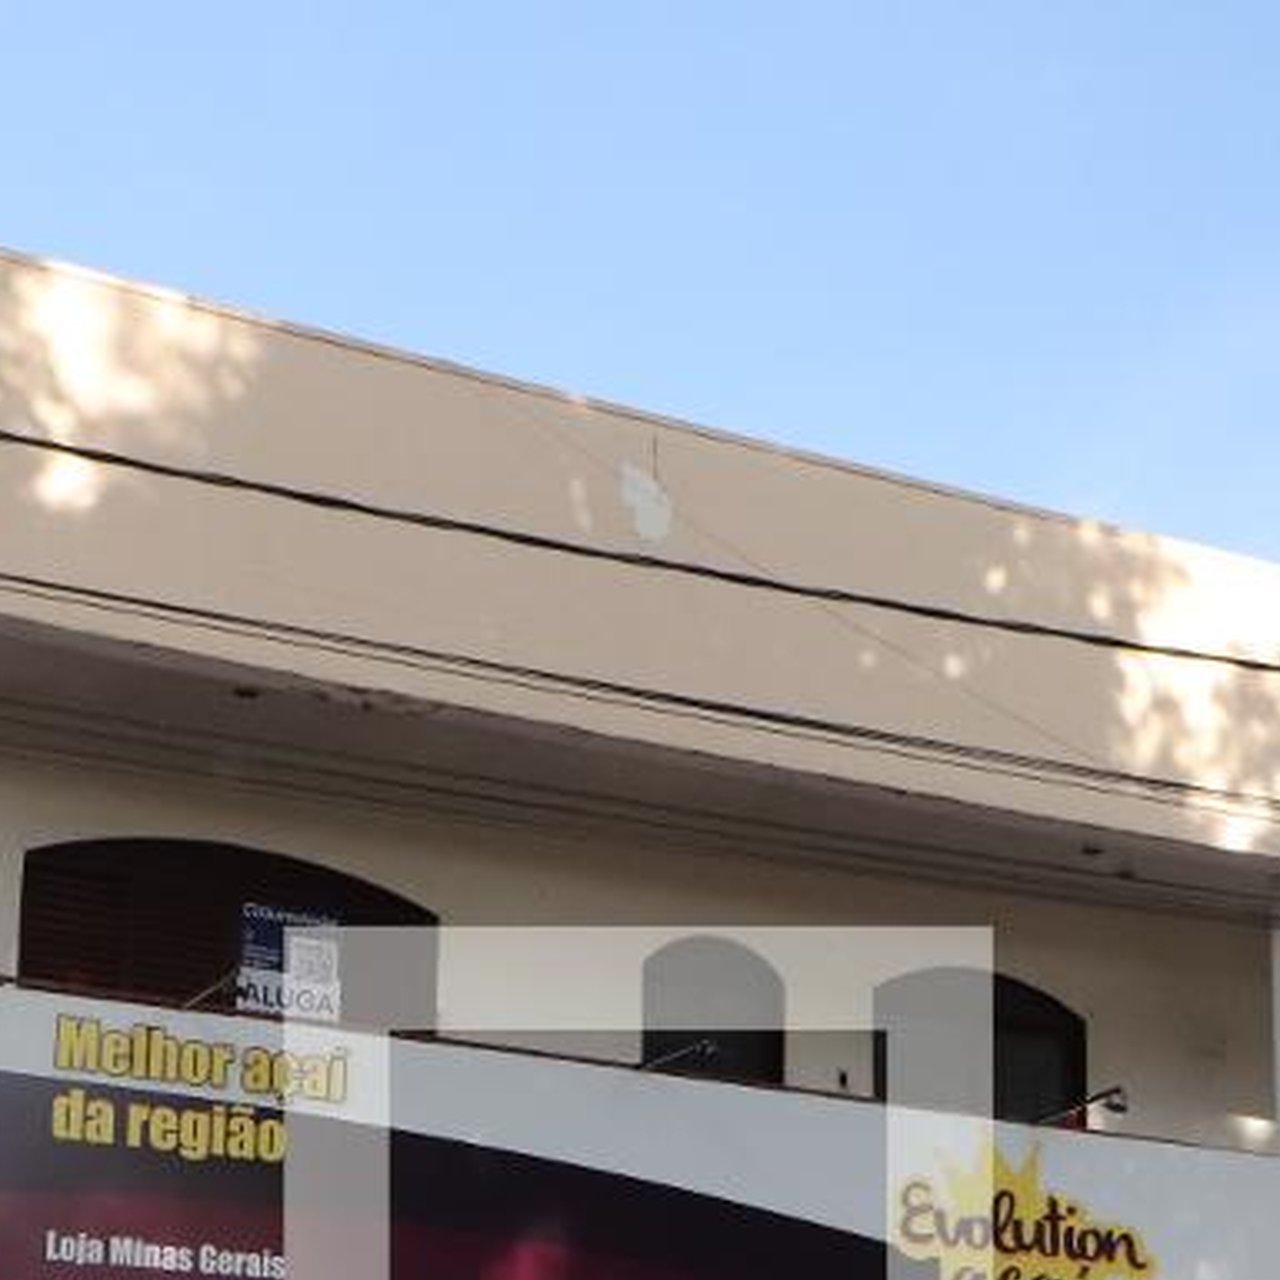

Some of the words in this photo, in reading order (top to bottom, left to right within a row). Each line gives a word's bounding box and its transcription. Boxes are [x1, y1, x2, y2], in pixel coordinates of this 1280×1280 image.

[240, 982, 334, 1014] ALUGA
[54, 1012, 235, 1089] Melhor
[51, 1087, 115, 1146] da
[126, 1100, 288, 1163] região
[45, 1230, 105, 1265] Loja
[109, 1236, 194, 1273] Minas
[199, 1244, 288, 1280] Gerais
[899, 1182, 1148, 1271] Evolution
